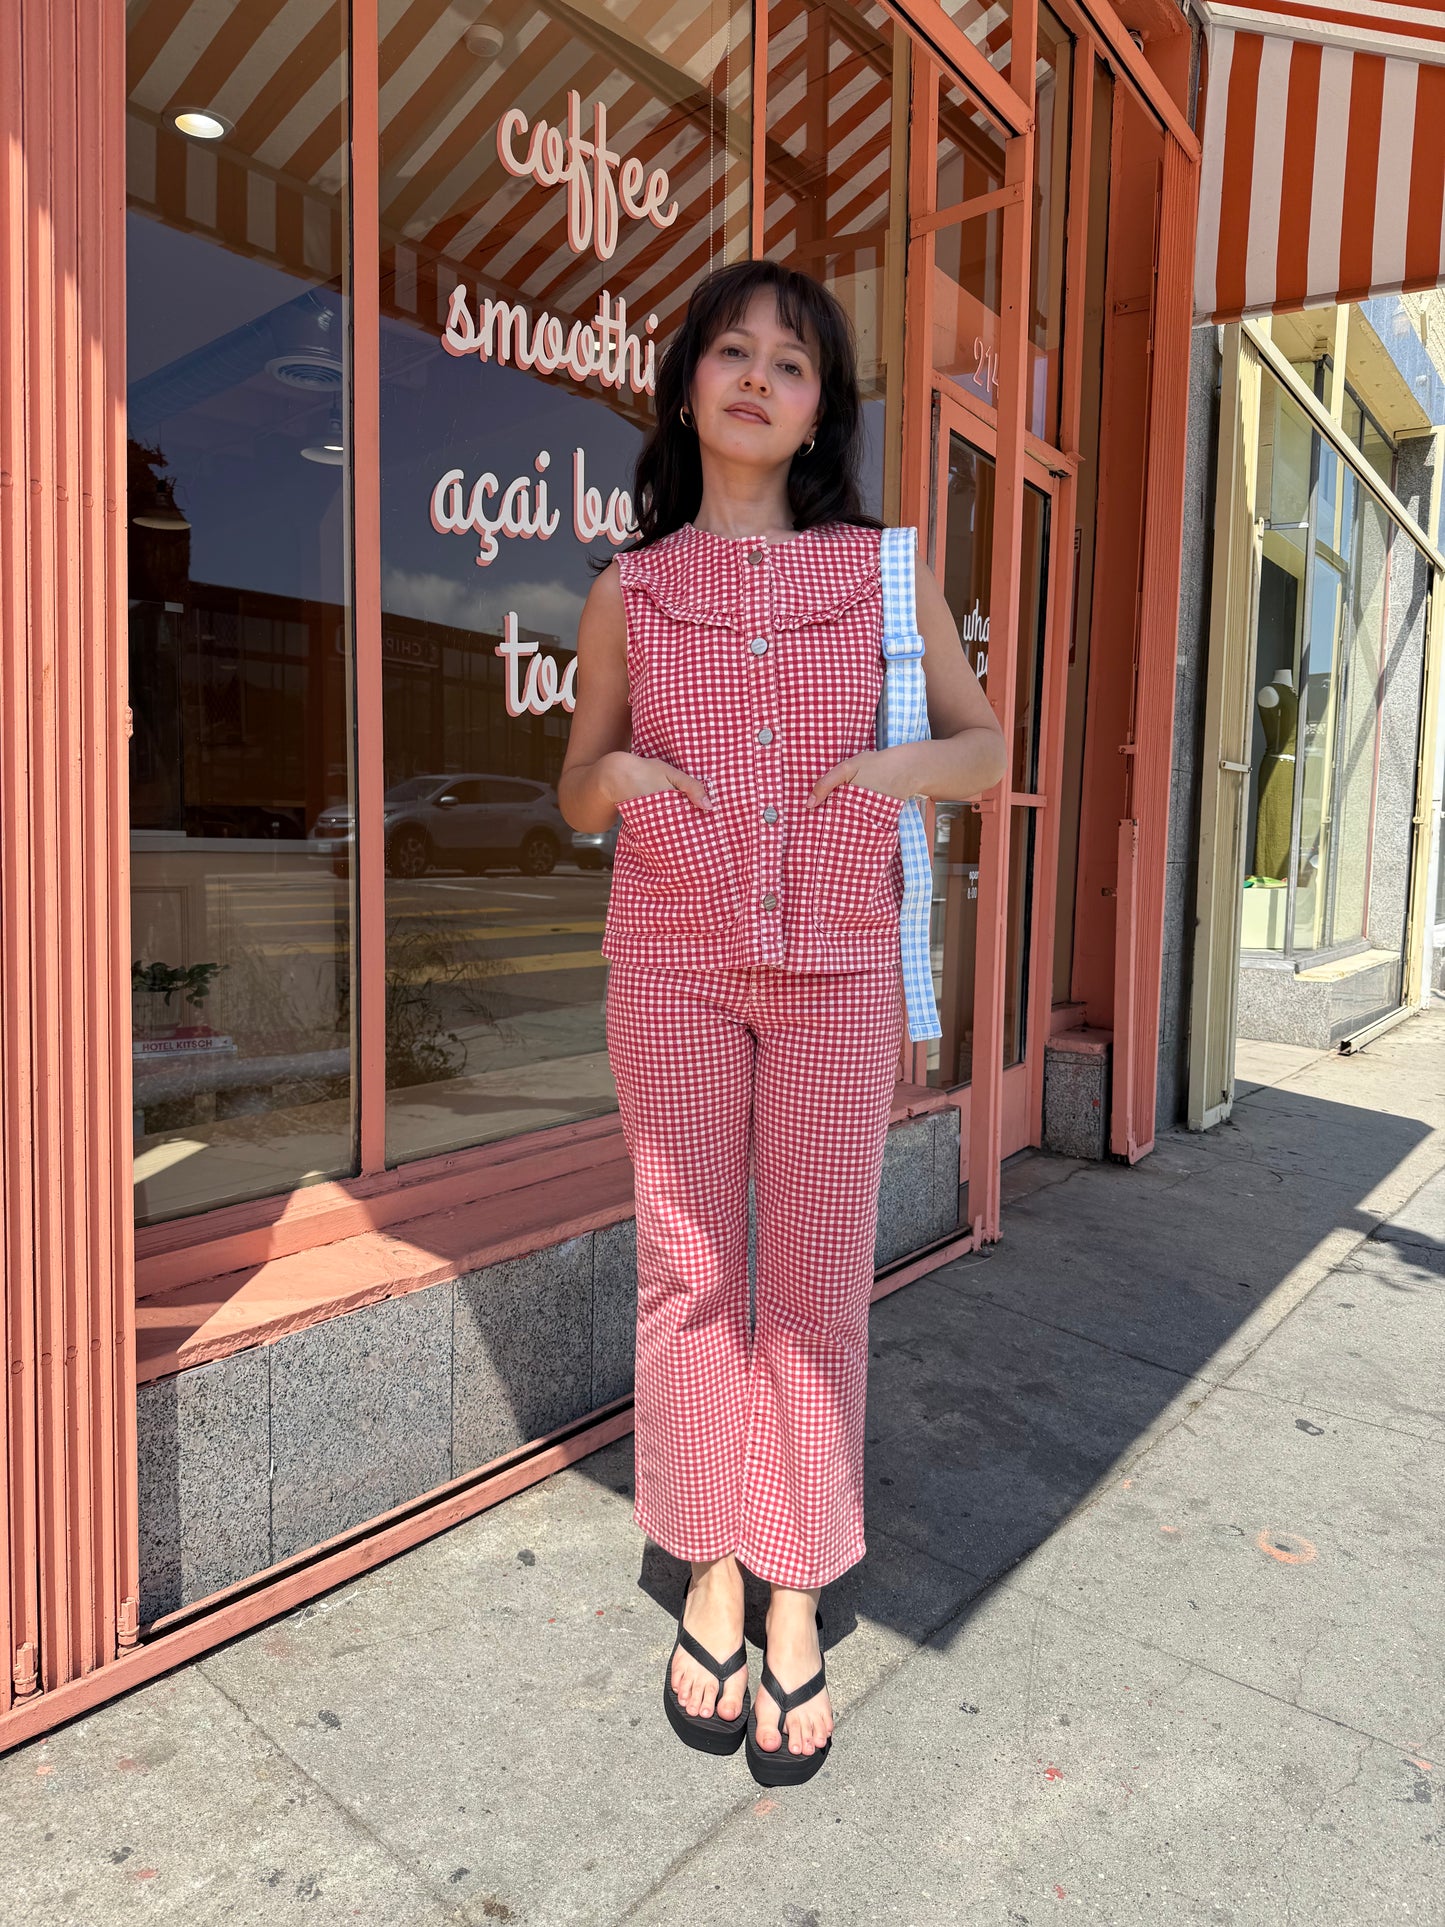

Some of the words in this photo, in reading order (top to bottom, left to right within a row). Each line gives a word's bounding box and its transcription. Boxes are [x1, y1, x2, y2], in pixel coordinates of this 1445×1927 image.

[496, 89, 679, 261] coffee
[441, 284, 657, 396] smoothi
[430, 450, 560, 567] açai
[573, 447, 647, 546] bo
[963, 598, 990, 642] wha
[142, 1042, 174, 1052] HOTEL
[176, 1039, 213, 1049] KITSCH
